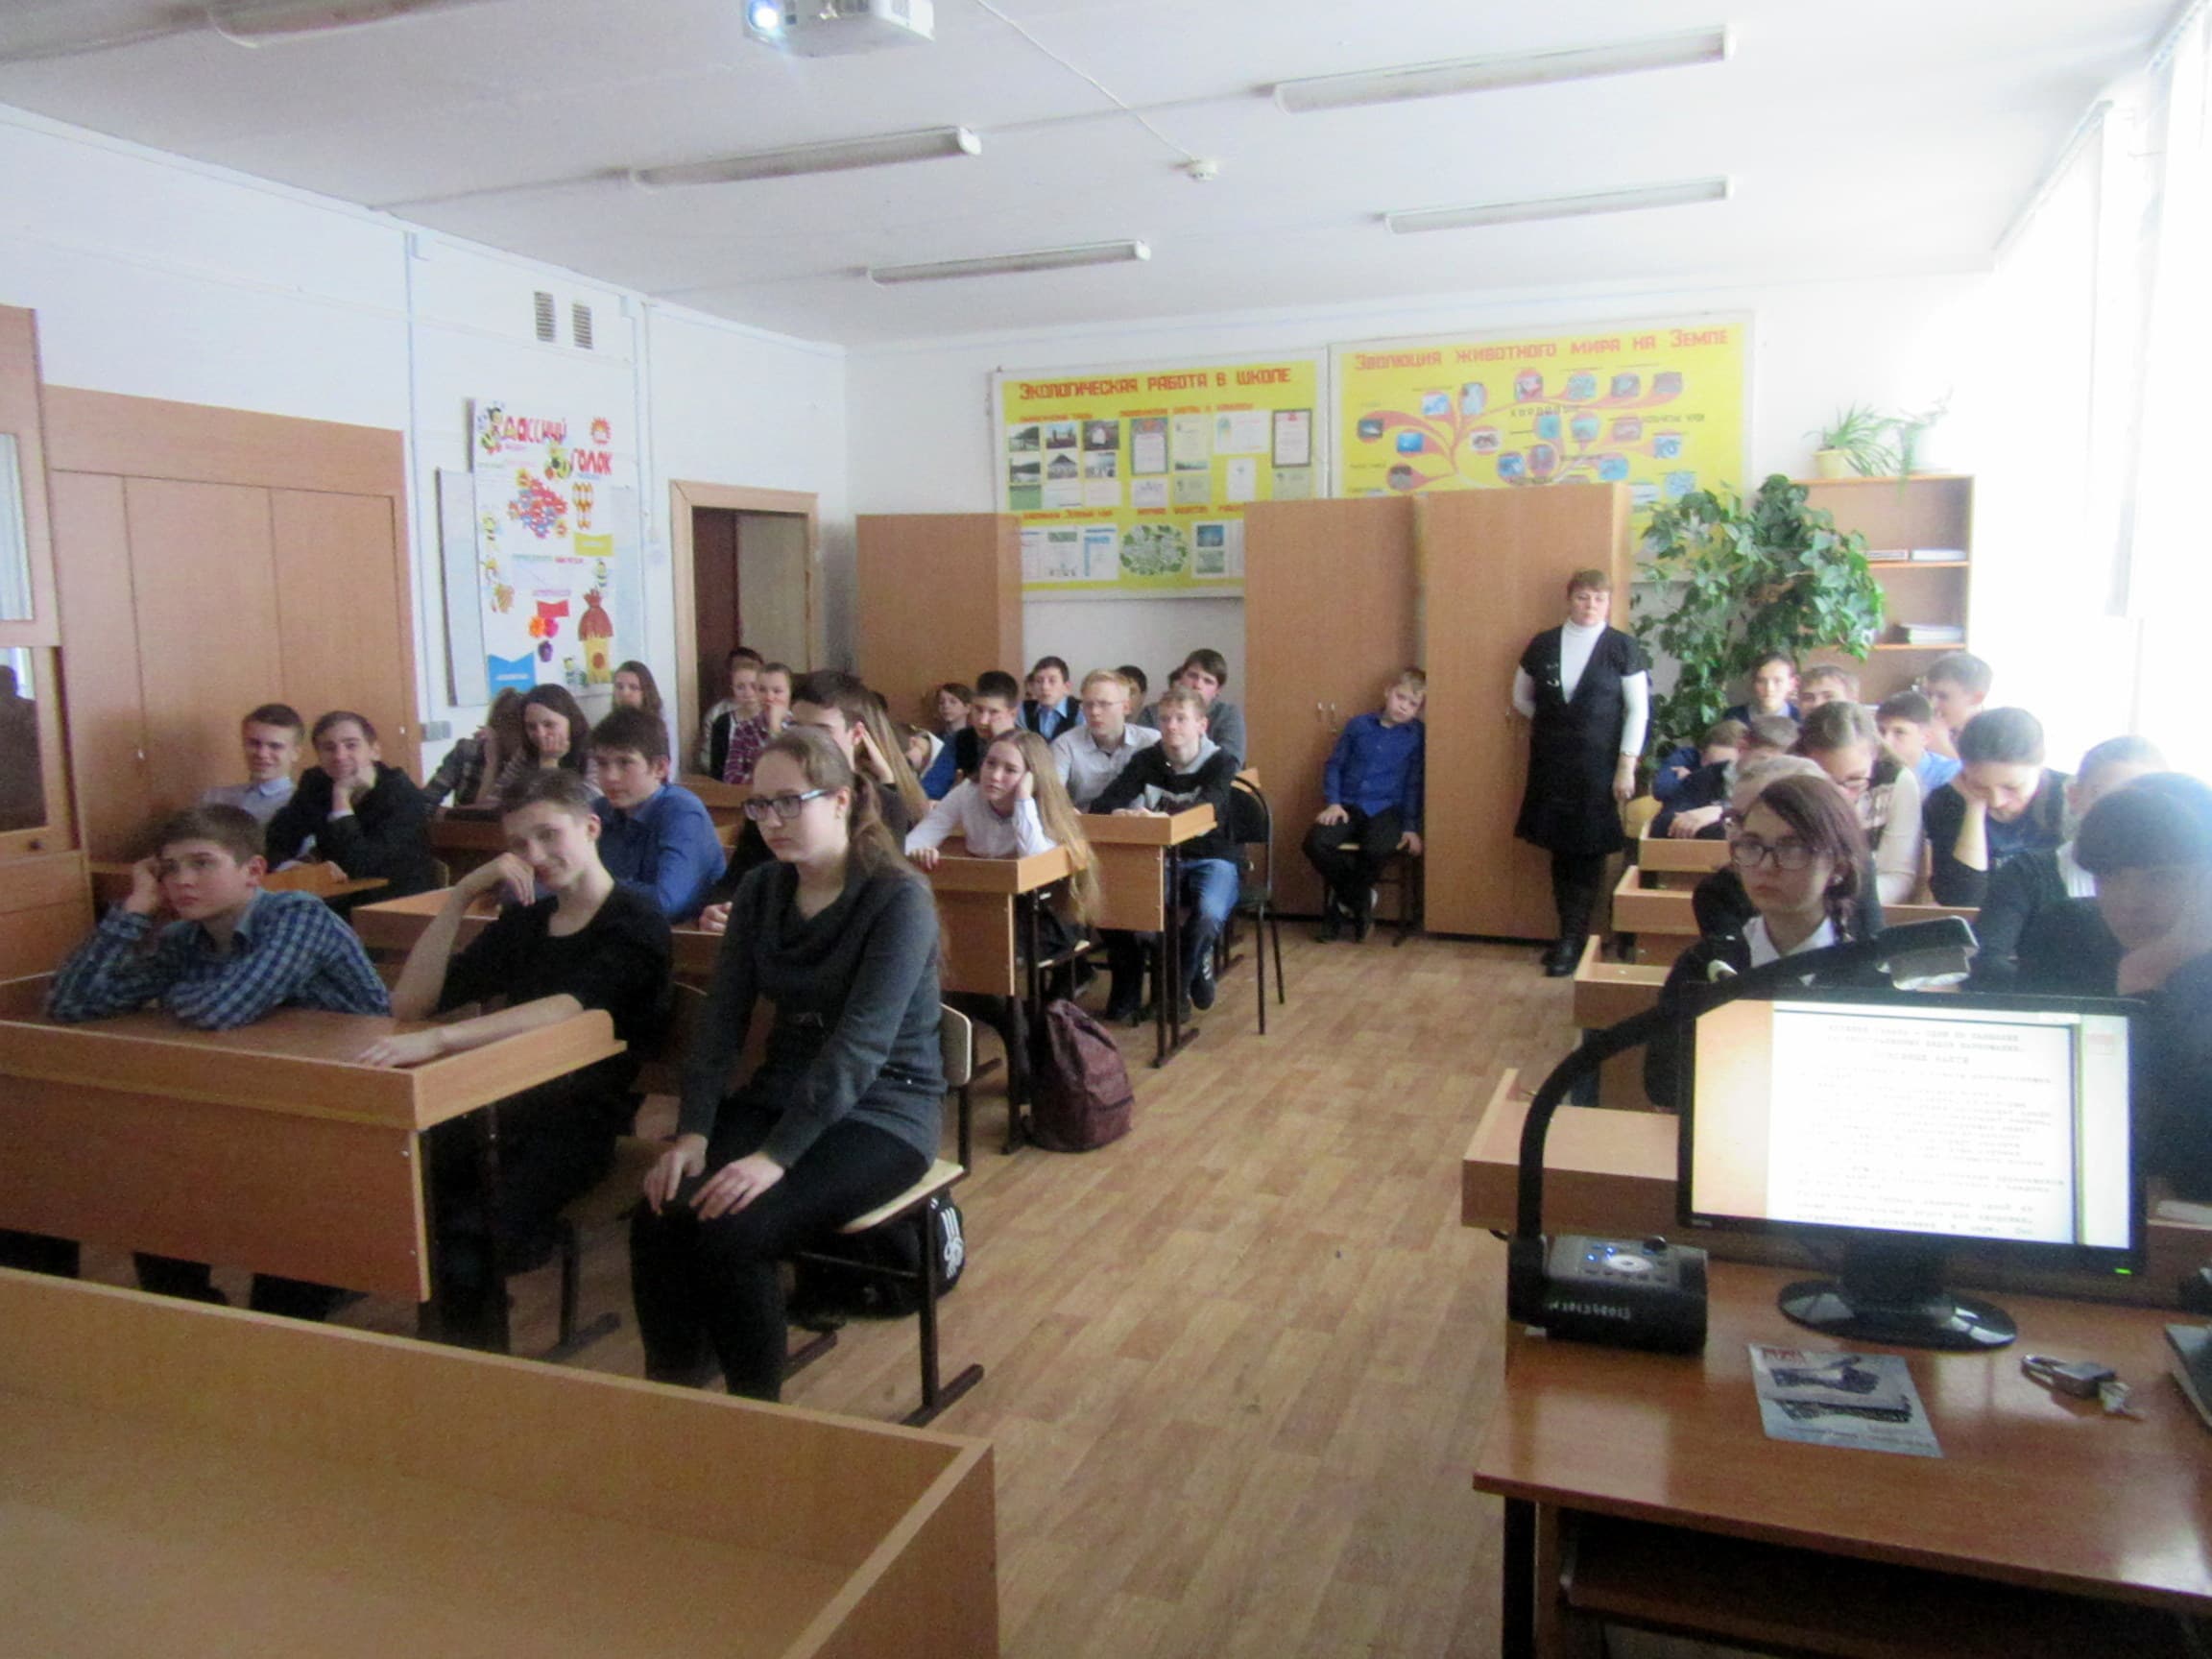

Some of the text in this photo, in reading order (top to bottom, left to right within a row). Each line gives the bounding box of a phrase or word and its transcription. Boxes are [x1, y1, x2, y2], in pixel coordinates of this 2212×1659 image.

[1456, 343, 1556, 363] ЖИВОТНОГО
[1571, 338, 1621, 354] МИРА
[1633, 335, 1655, 350] НА
[1147, 373, 1207, 391] РАБОТА
[1215, 372, 1227, 387] В
[1237, 368, 1291, 385] ШКОЛЕ
